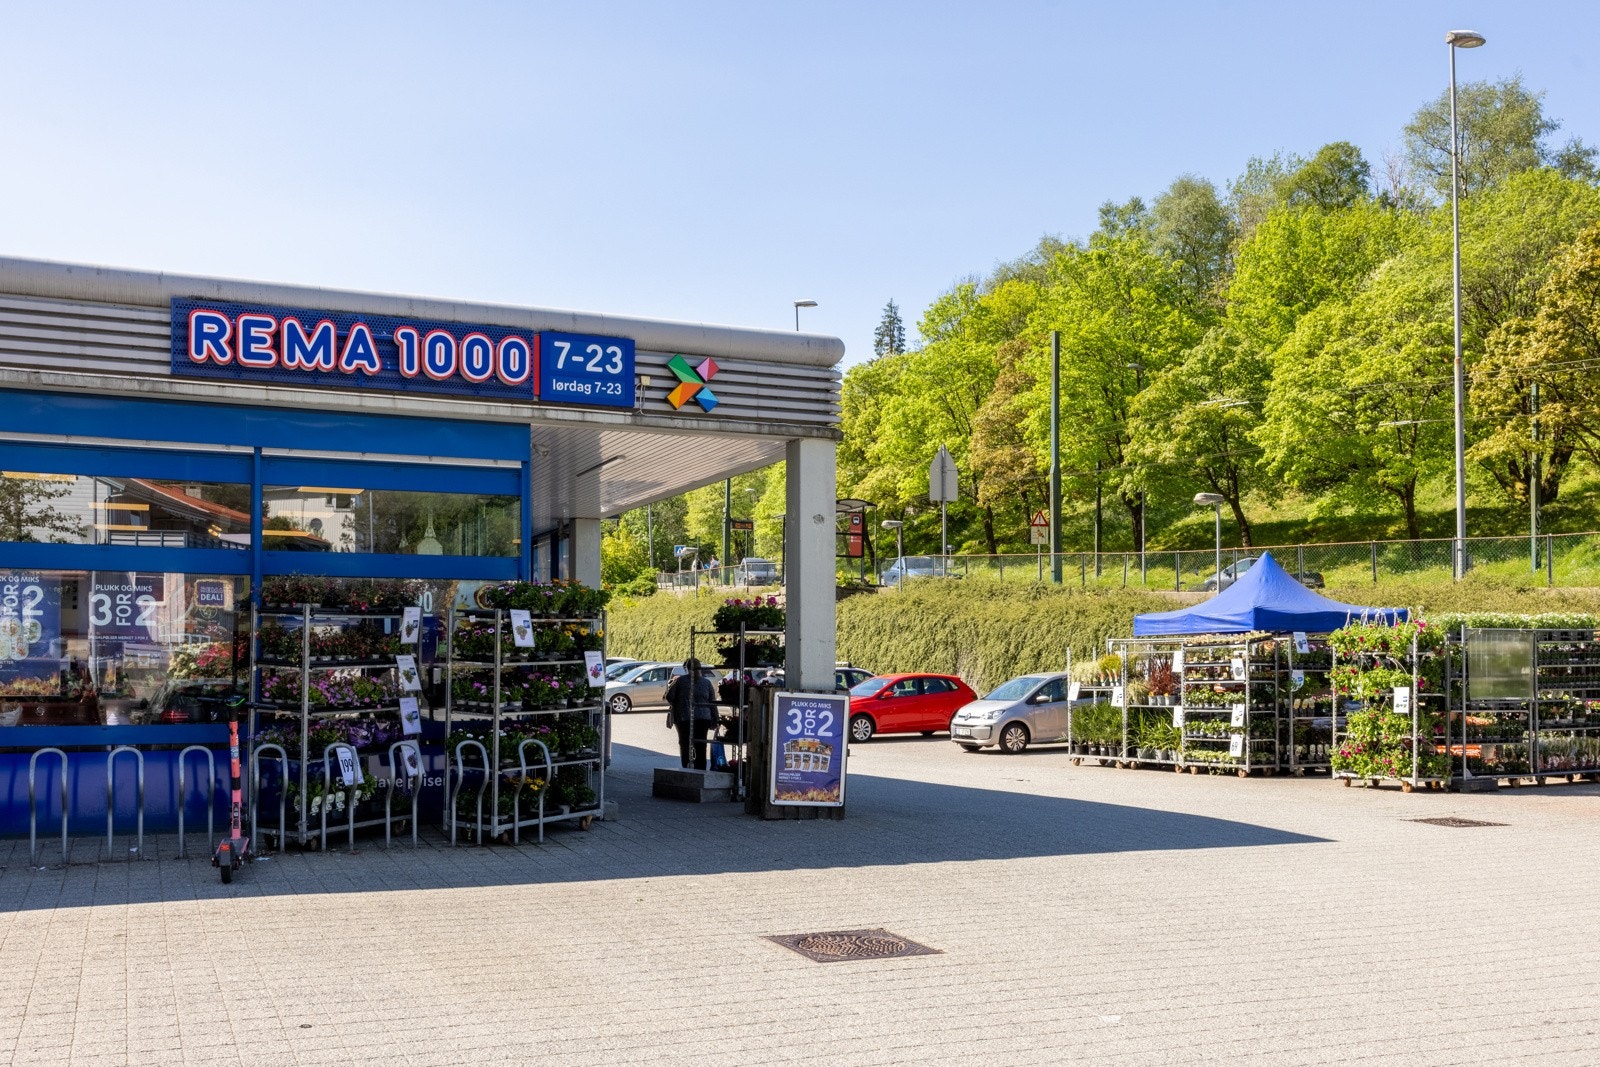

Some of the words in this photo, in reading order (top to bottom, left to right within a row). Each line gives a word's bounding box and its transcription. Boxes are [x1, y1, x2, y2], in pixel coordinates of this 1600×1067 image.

[188, 309, 382, 376] REMA
[394, 326, 531, 386] 1000
[554, 341, 623, 374] 7-23
[552, 378, 592, 395] lørdag
[594, 381, 622, 395] 7-23
[8, 575, 20, 583] OG
[3, 584, 18, 616] FOR
[22, 585, 44, 616] 2
[90, 593, 112, 626] 3
[116, 593, 132, 626] FOR
[134, 594, 157, 626] 2
[200, 593, 223, 601] DEAL!
[786, 708, 802, 735] 3
[804, 709, 817, 736] FOR
[817, 711, 834, 737] 2
[407, 774, 446, 790] pise
